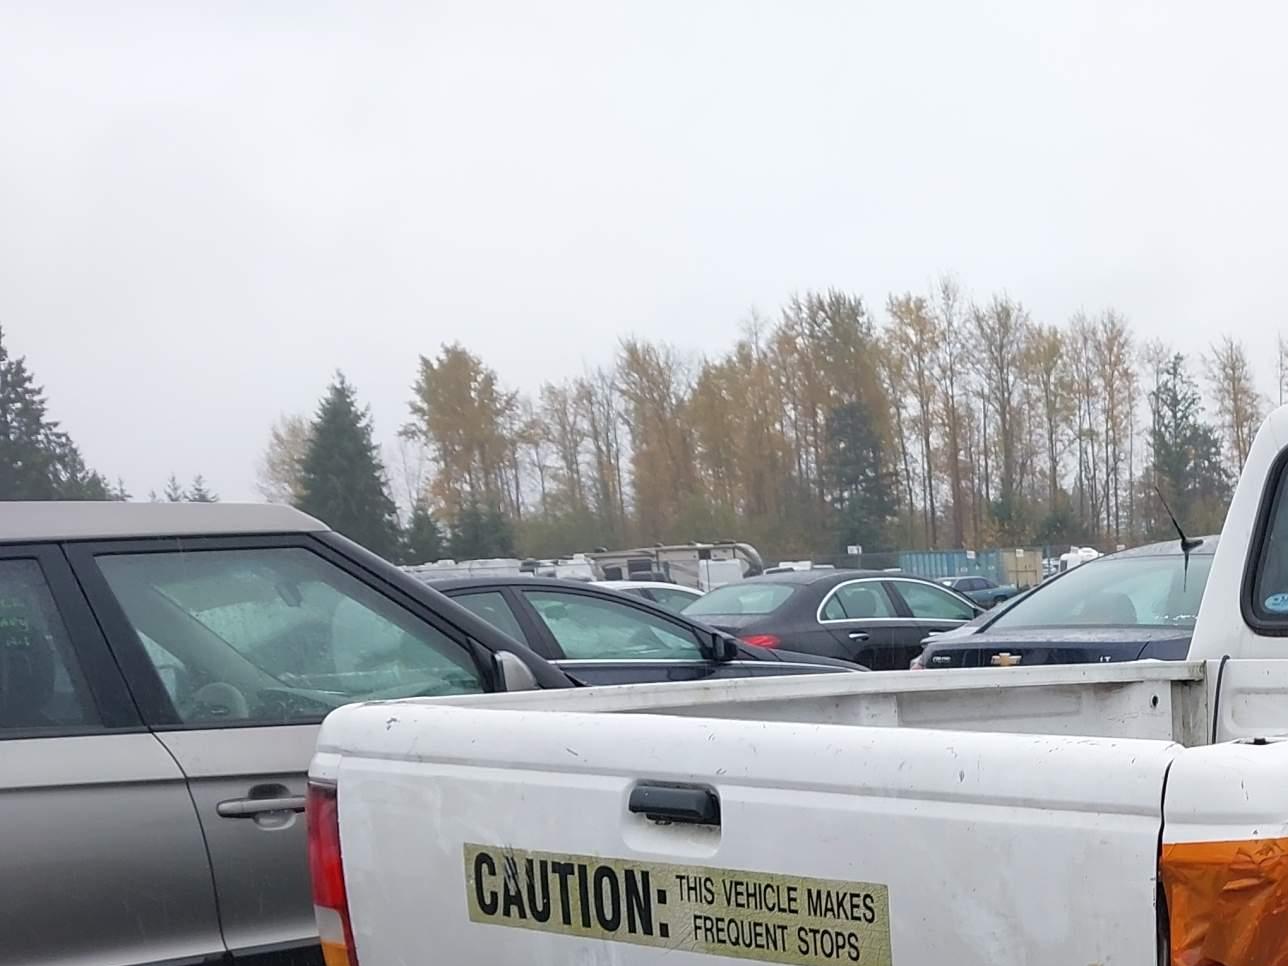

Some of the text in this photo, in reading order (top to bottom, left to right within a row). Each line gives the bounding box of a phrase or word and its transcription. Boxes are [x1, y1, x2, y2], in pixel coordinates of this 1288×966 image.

[473, 851, 670, 938] CAUTION:
[675, 874, 876, 924] THIS VEHICLE MAKES
[693, 914, 860, 962] FREQUENT STOPS
